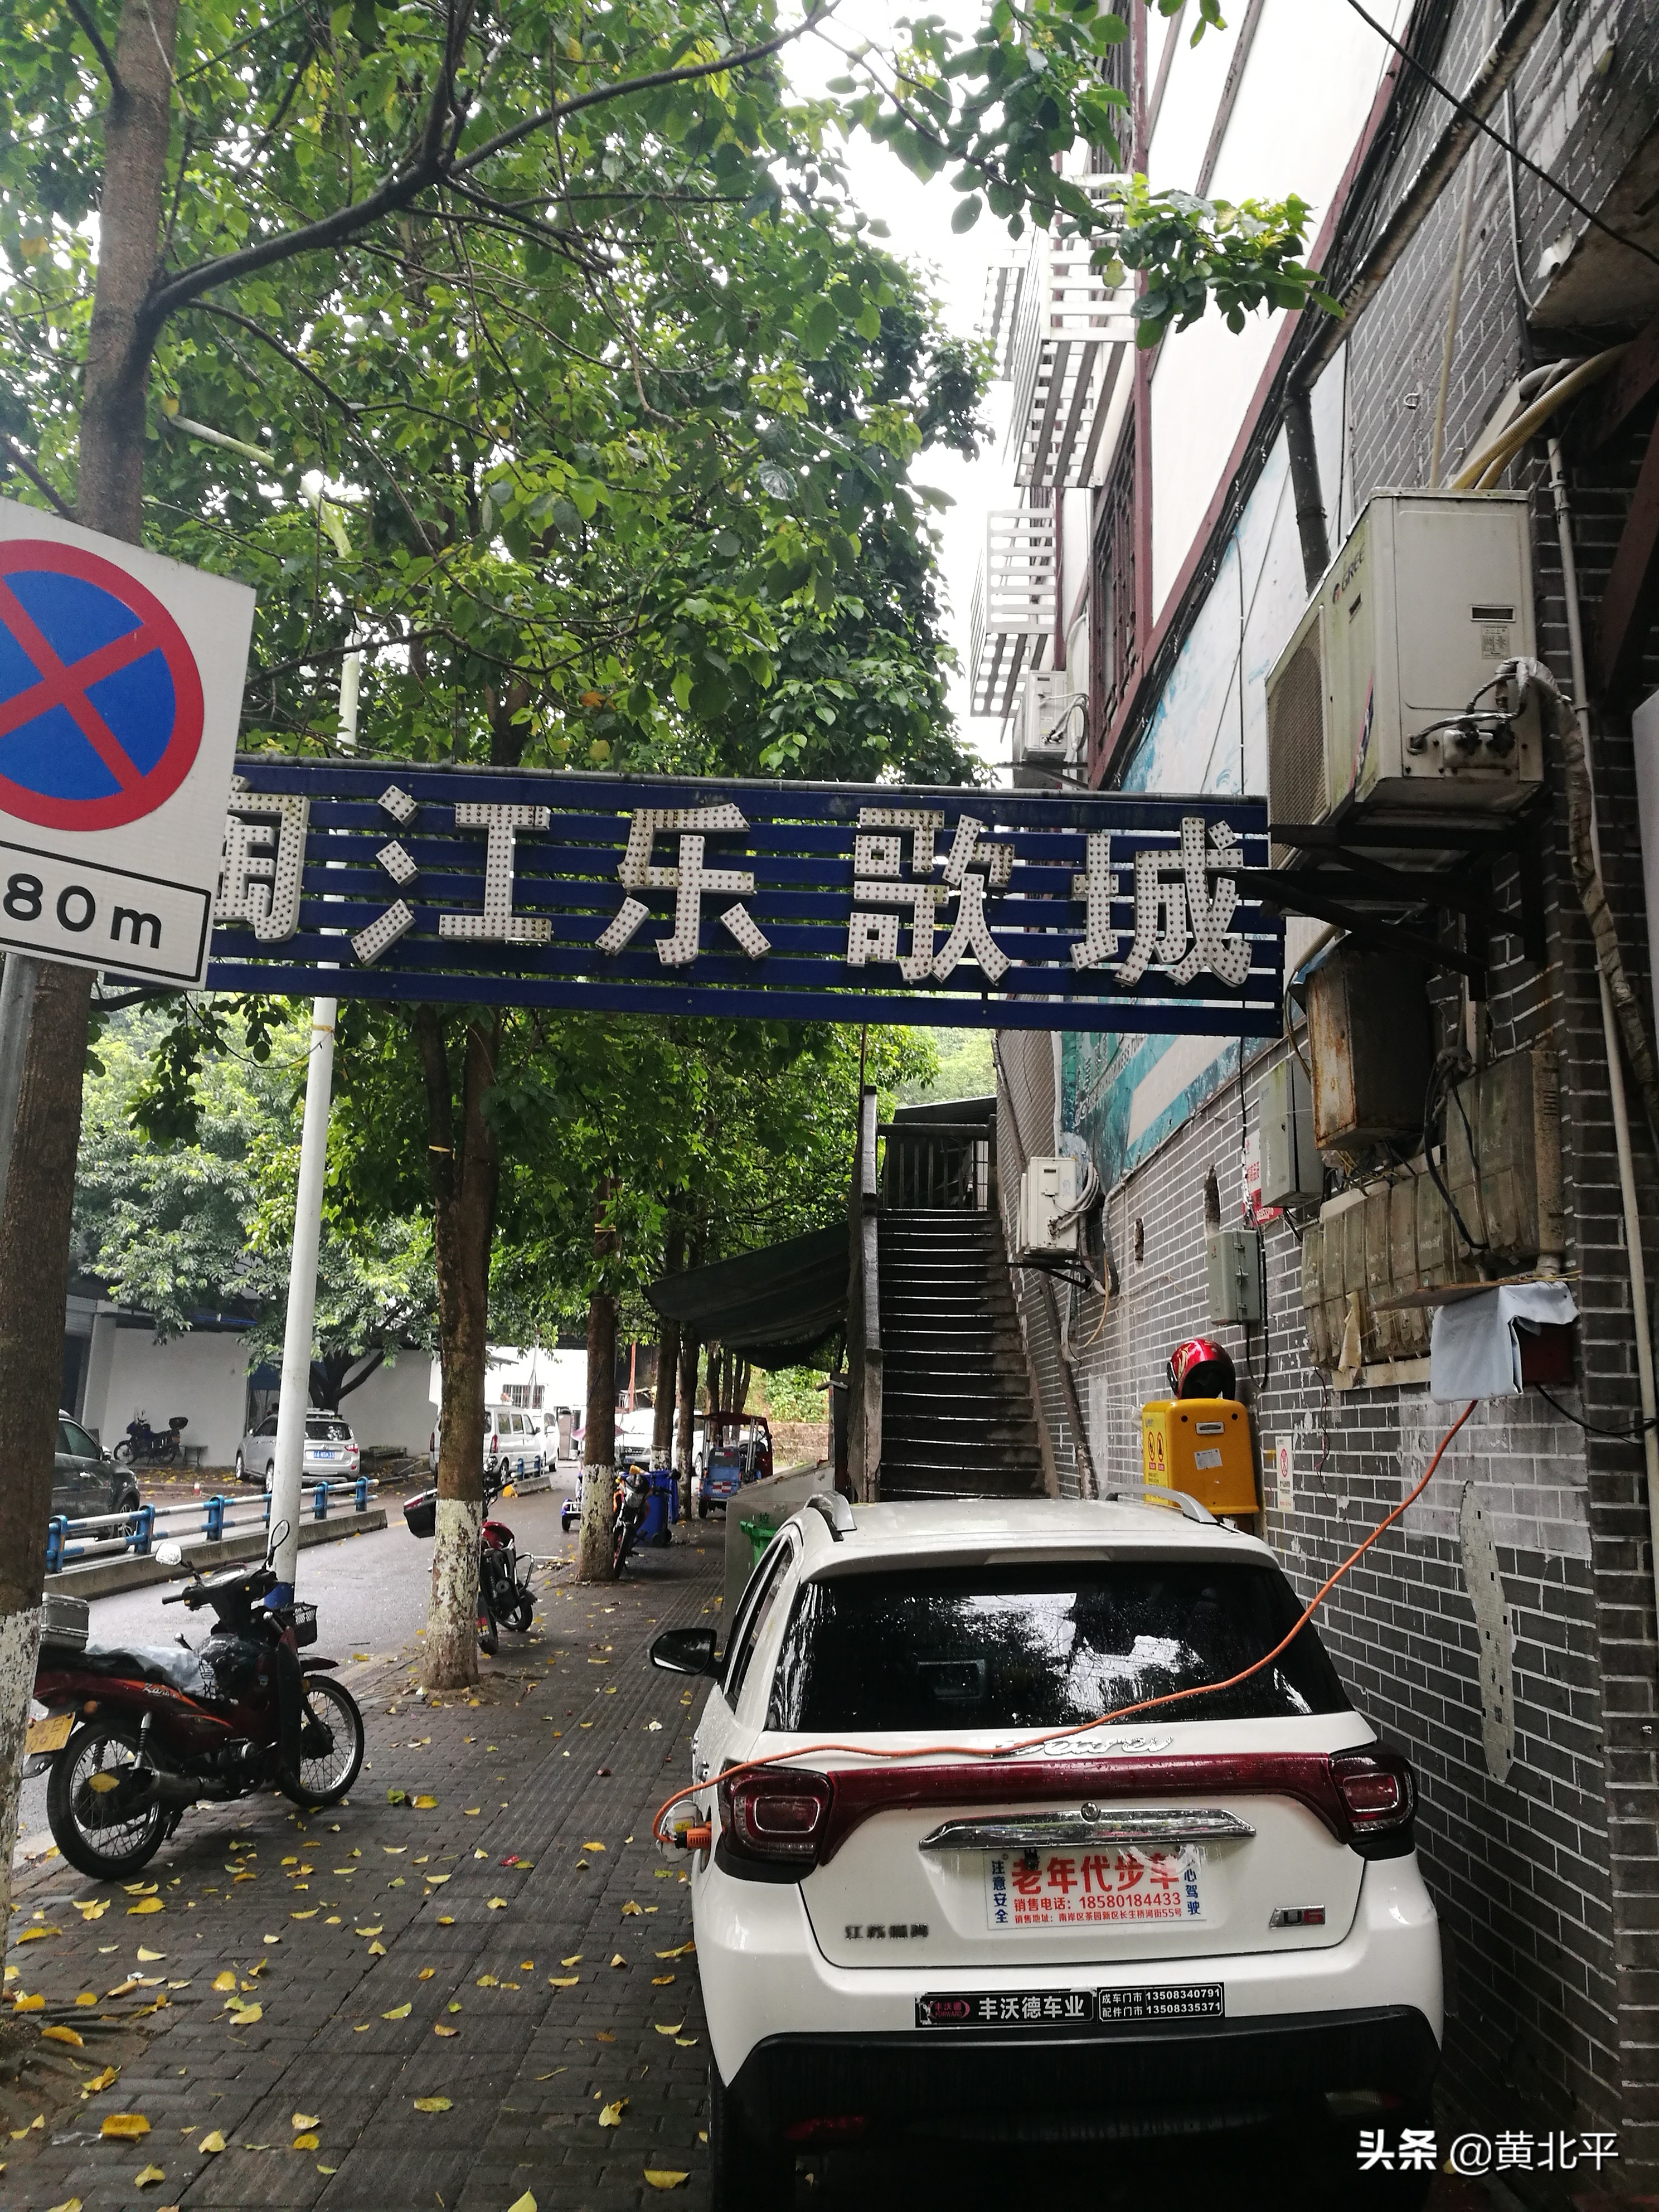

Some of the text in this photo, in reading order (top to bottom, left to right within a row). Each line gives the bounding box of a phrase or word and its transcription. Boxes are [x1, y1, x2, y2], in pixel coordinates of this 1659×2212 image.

[1011, 1852, 1180, 1895] 老年代步车
[991, 1860, 1008, 1924] 注意安全
[1183, 1857, 1201, 1916] 心驾驶
[1283, 1908, 1323, 1924] U6
[978, 1996, 1085, 2020] 丰沃德车业
[1102, 1988, 1220, 2005] 成车门市 13508340791
[1102, 2002, 1221, 2018] 配件门市 13508335371
